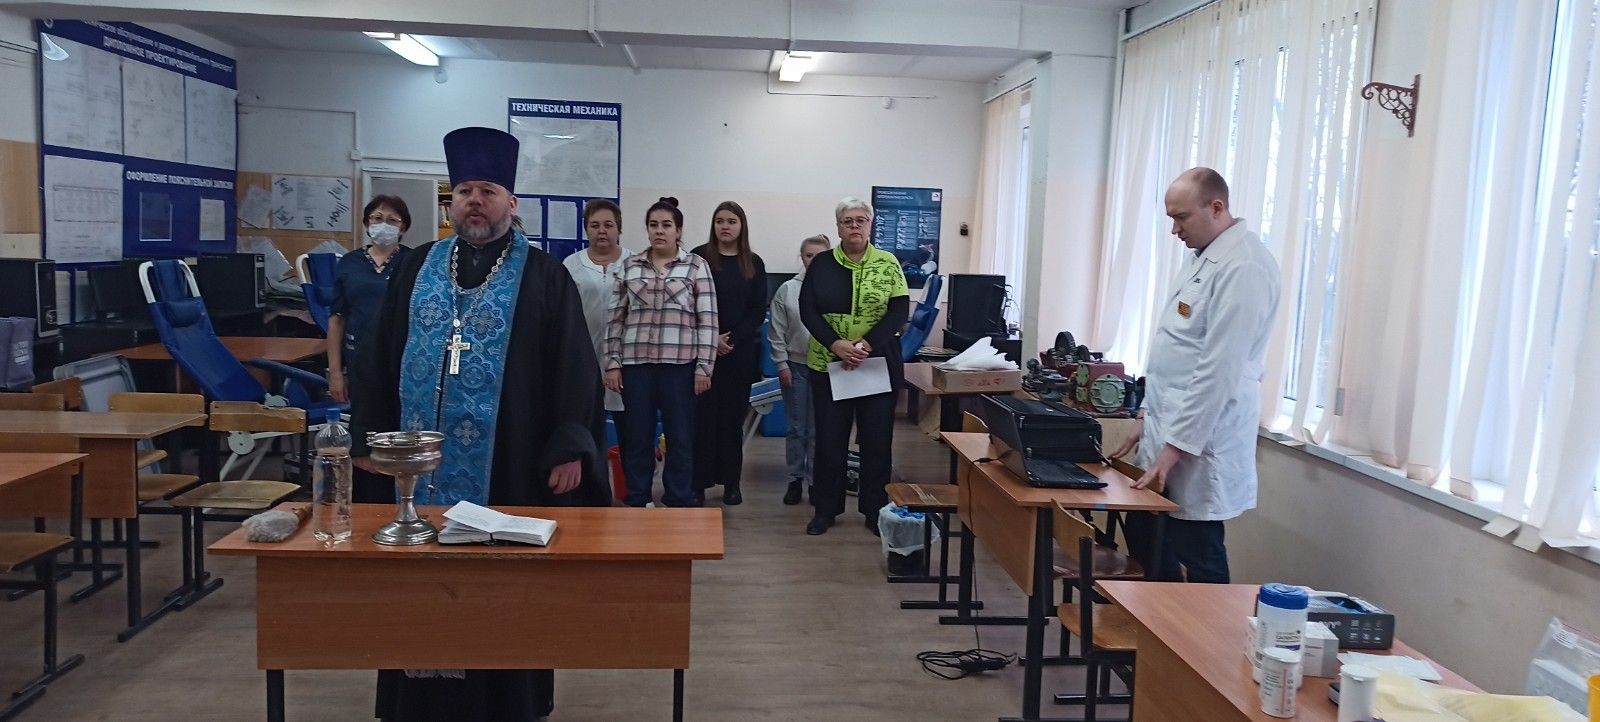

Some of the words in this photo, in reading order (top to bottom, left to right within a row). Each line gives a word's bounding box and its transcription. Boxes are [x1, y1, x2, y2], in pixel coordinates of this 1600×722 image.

[103, 35, 145, 58] ДИПЛОМНОЕ
[145, 49, 198, 74] ПРОЕКТИРОВАНИЕ
[511, 102, 571, 114] ТЕХНИЧЕСКАЯ
[573, 106, 618, 116] МЕХАНИКА
[126, 170, 168, 184] ОФОРМЛЕНИЕ
[168, 174, 213, 188] ПОЯСНИТЕЛЬНОЙ
[213, 180, 234, 190] ЗАПИСКИ
